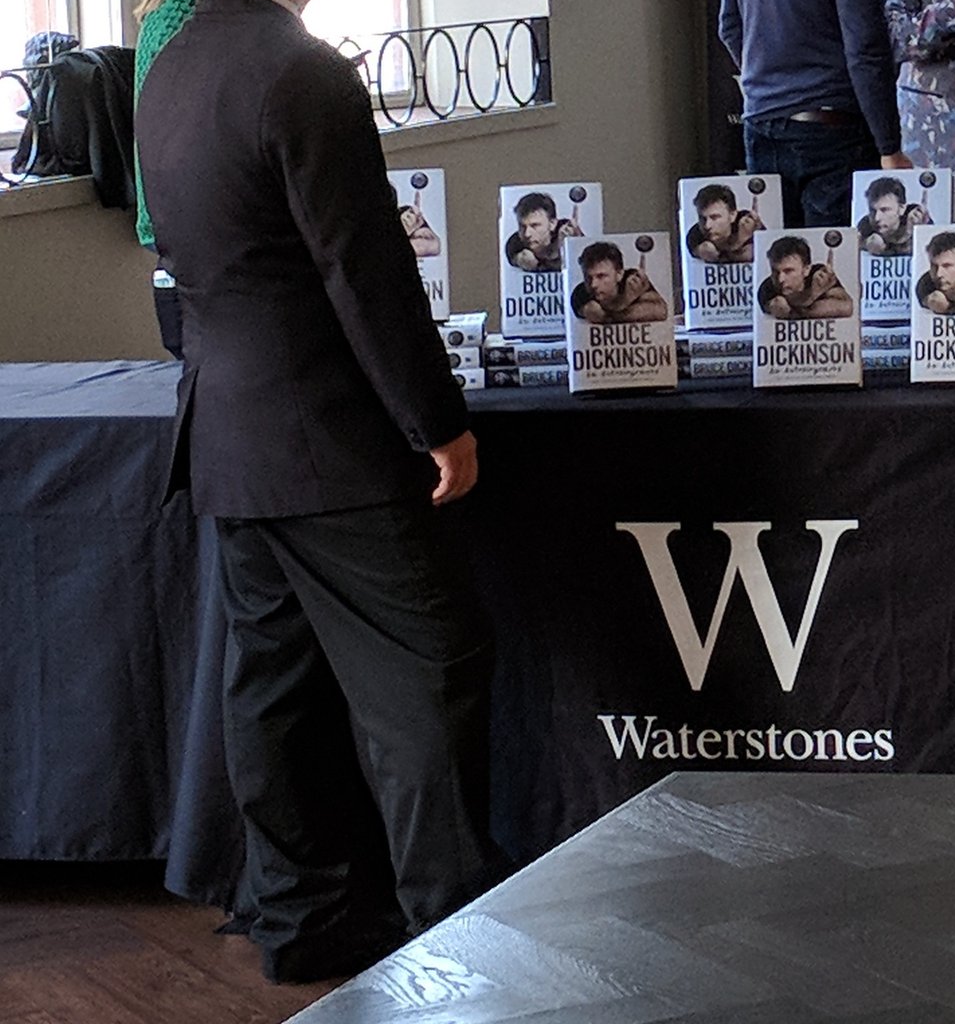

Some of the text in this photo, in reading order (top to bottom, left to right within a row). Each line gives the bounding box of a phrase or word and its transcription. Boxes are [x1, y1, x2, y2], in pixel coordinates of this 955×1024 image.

[705, 264, 752, 286] BRUC
[871, 257, 911, 278] BRU
[523, 272, 563, 294] BRU
[866, 280, 910, 300] ICKIN
[506, 295, 564, 317] DICKIN
[590, 324, 651, 347] BRUCE
[775, 320, 836, 343] BRUCE
[573, 345, 671, 371] DICKINSON
[757, 342, 854, 367] DICKINSON
[615, 519, 859, 692] W
[597, 714, 896, 761] Waterstones
